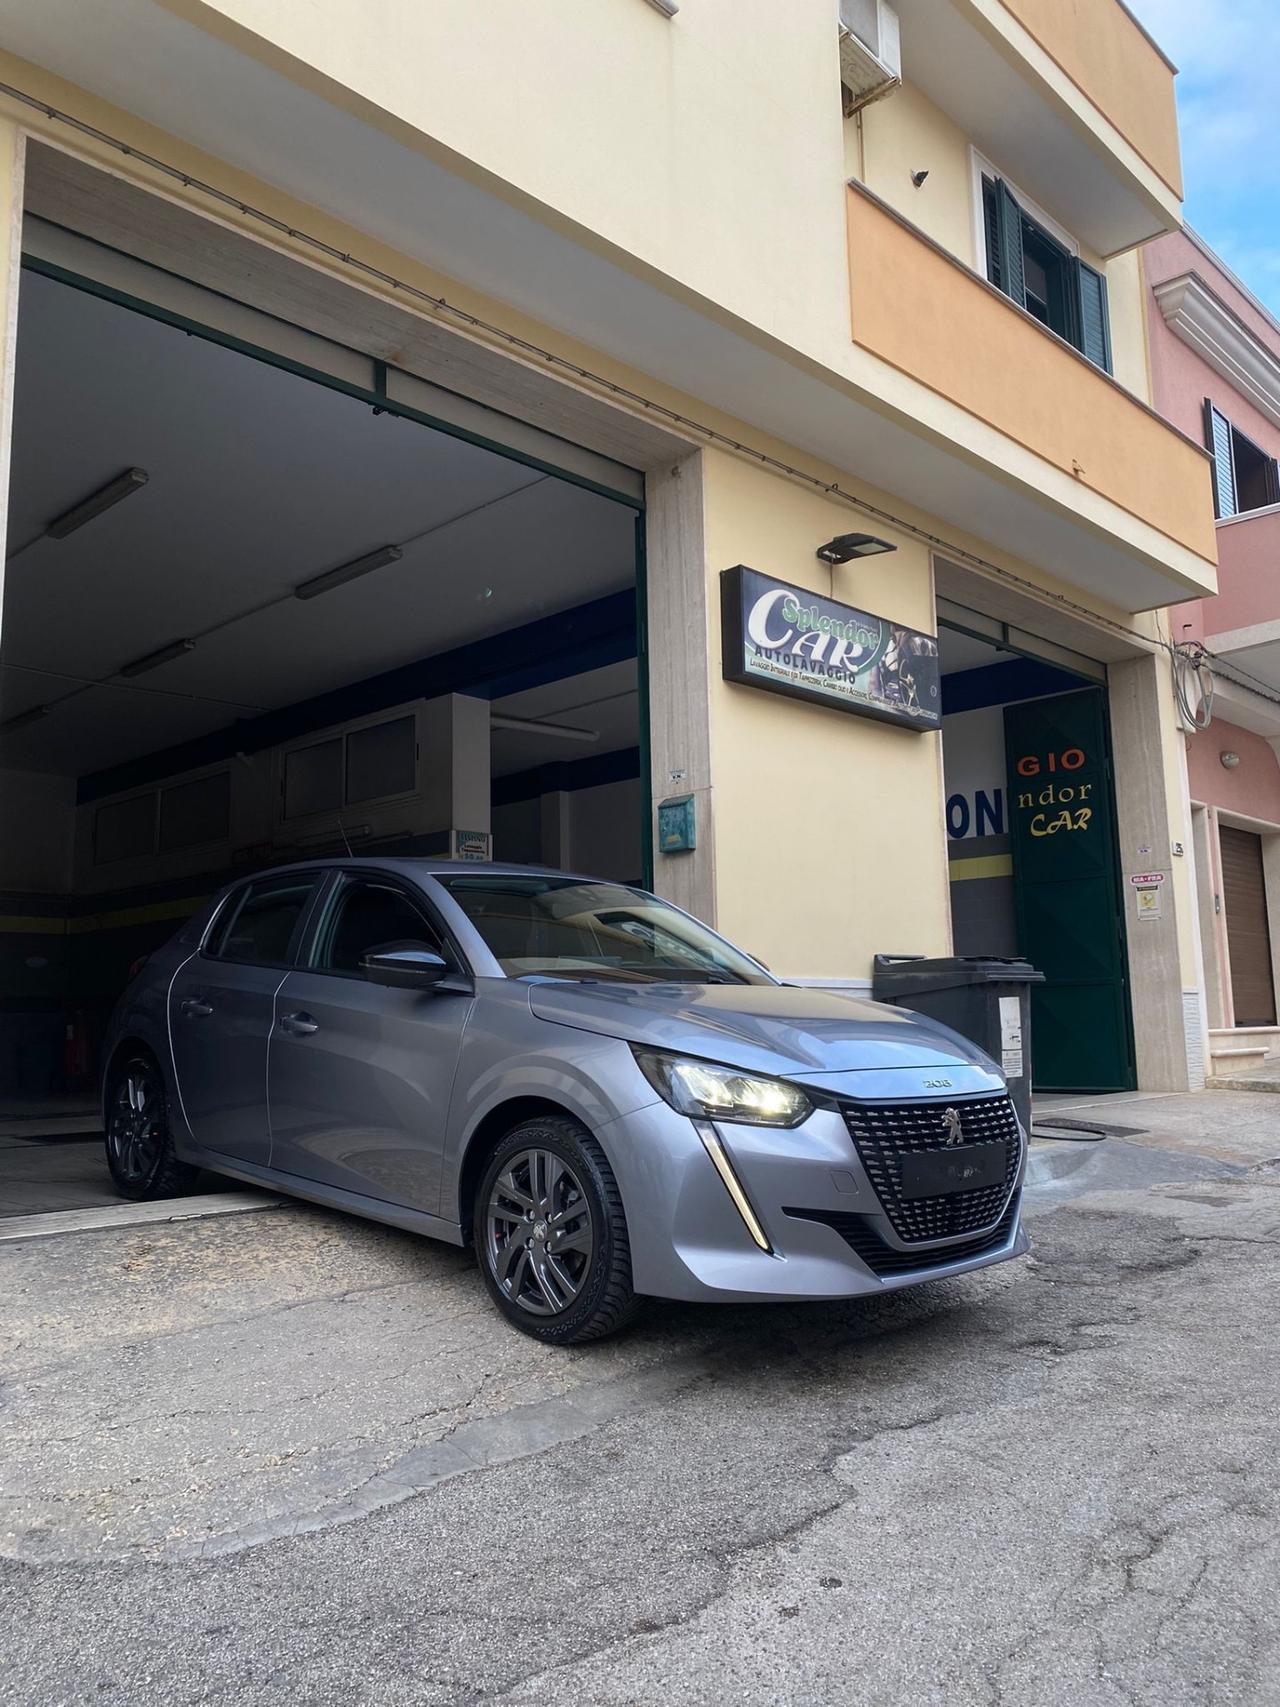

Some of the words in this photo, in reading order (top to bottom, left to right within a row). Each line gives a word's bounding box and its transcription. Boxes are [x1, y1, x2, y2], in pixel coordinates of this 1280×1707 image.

[748, 589, 863, 673] CAR
[782, 597, 879, 650] Splendor
[755, 646, 856, 684] AUTOLAVAGGIO
[1017, 748, 1086, 776] GIO
[946, 789, 1004, 839] ON
[1018, 784, 1092, 809] ndor
[1030, 808, 1092, 837] CAR
